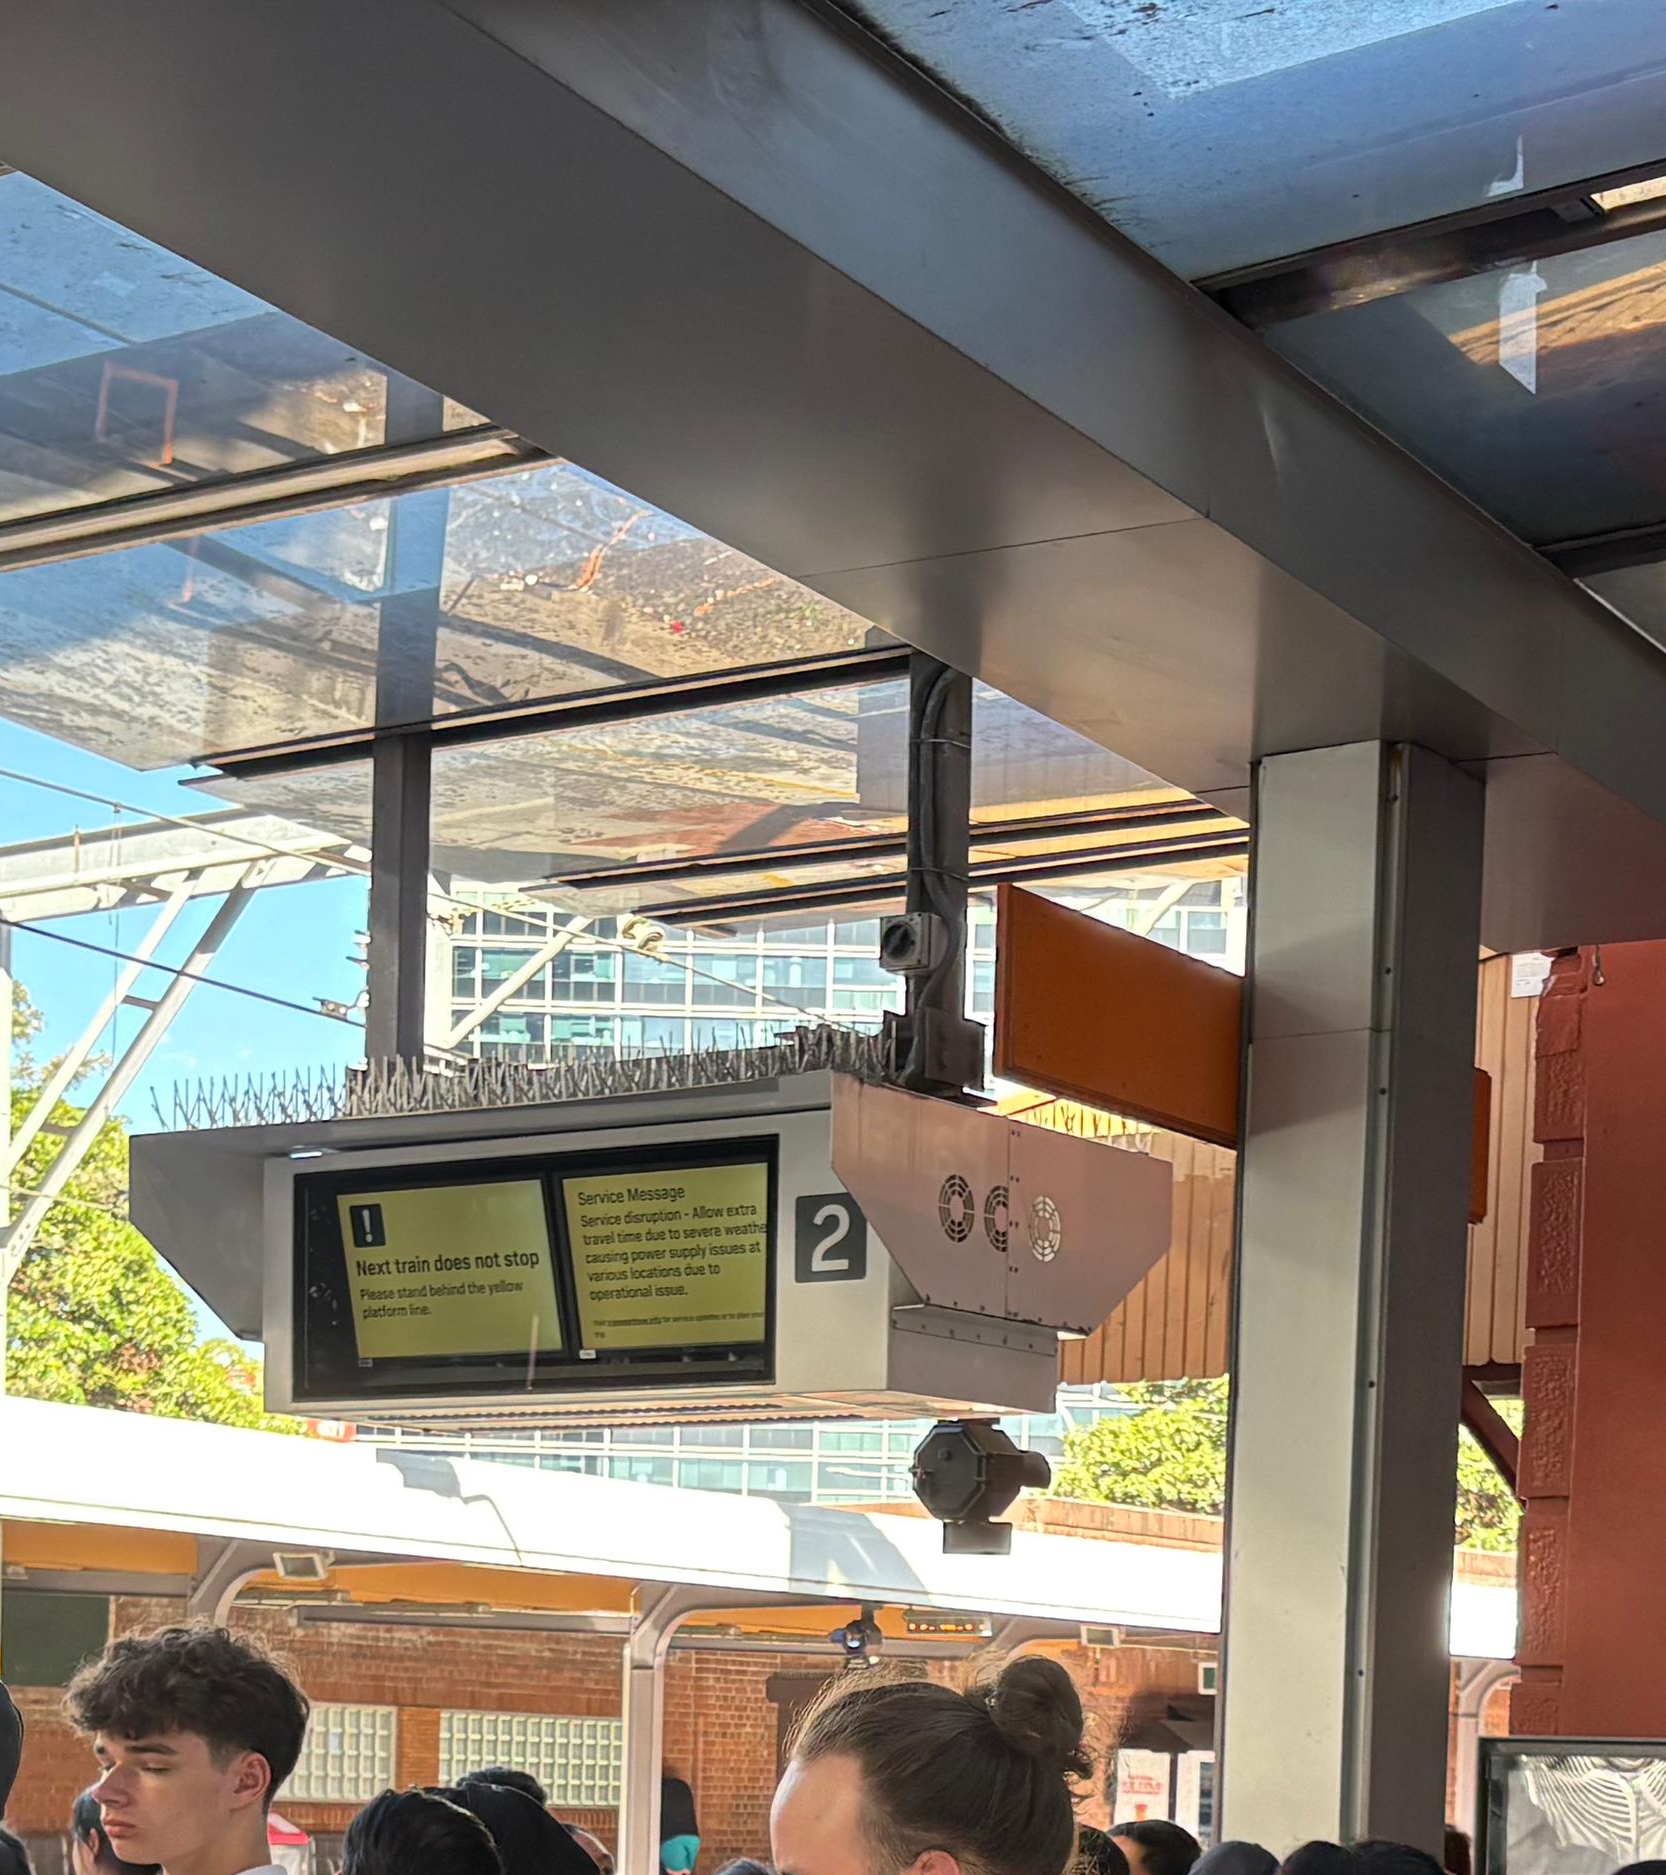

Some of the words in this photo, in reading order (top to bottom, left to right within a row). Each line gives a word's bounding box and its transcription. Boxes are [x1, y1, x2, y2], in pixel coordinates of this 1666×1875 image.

[578, 1189, 625, 1206] Service
[627, 1186, 685, 1203] Message
[581, 1213, 622, 1228] Service
[624, 1210, 682, 1226] disruption
[692, 1205, 724, 1220] Allow
[726, 1204, 757, 1217] extra
[583, 1231, 615, 1246] travel
[617, 1230, 643, 1244] time
[645, 1228, 666, 1242] due
[668, 1228, 681, 1240] to
[683, 1226, 722, 1240] severe
[811, 1204, 851, 1273] 2
[585, 1250, 629, 1265] causing
[631, 1249, 667, 1264] power
[669, 1244, 707, 1260] supply
[709, 1242, 746, 1256] issues
[749, 1241, 761, 1254] at
[356, 1259, 393, 1277] Next
[395, 1256, 430, 1274] train
[434, 1254, 471, 1272] does
[475, 1252, 501, 1270] not
[504, 1251, 540, 1269] stop
[588, 1268, 628, 1282] various
[630, 1265, 682, 1279] locations
[684, 1262, 706, 1276] due
[708, 1263, 721, 1275] to
[360, 1287, 396, 1301] Please
[397, 1285, 427, 1299] stand
[430, 1283, 467, 1297] behind
[468, 1281, 486, 1294] the
[488, 1280, 524, 1295] yellow
[589, 1284, 653, 1301] operational
[362, 1304, 408, 1320] platform
